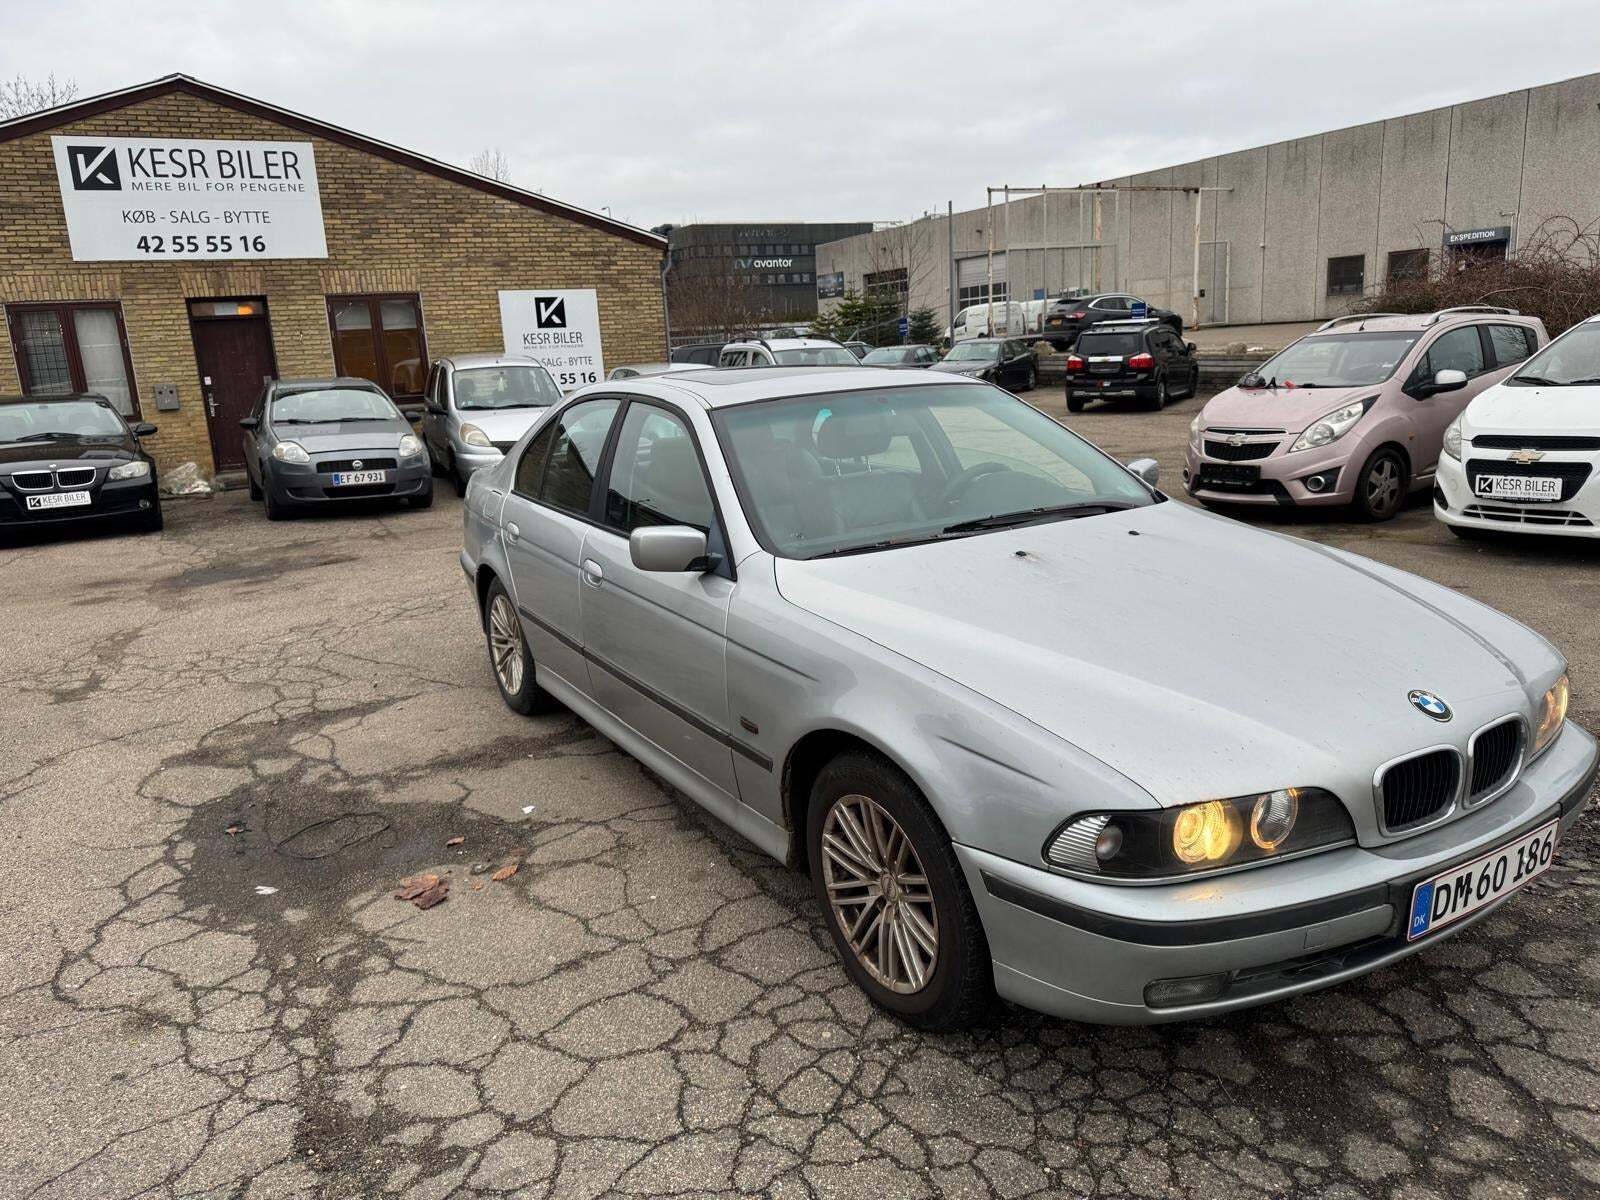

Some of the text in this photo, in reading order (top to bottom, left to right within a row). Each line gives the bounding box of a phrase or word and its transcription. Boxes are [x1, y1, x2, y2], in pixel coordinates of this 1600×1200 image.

[127, 147, 301, 180] KESR BILER
[131, 182, 305, 192] MERE BIL FOR PENGENE
[121, 209, 156, 224] KØB
[169, 210, 210, 224] SALG
[223, 210, 271, 224] BYTTE
[1450, 230, 1495, 242] EKSPEDITION
[136, 235, 266, 253] 42 55 55 16
[753, 258, 793, 268] avantor
[523, 331, 583, 345] KESR BILER
[541, 357, 562, 367] SALG
[568, 356, 593, 367] BYTTE
[560, 371, 597, 385] 55 16
[340, 474, 351, 484] EF
[354, 473, 365, 482] 67
[367, 472, 383, 482] 931
[1496, 478, 1522, 491] KESR
[1524, 480, 1555, 492] BILER
[1431, 829, 1553, 922] DM 60 186
[1413, 912, 1426, 928] DK
